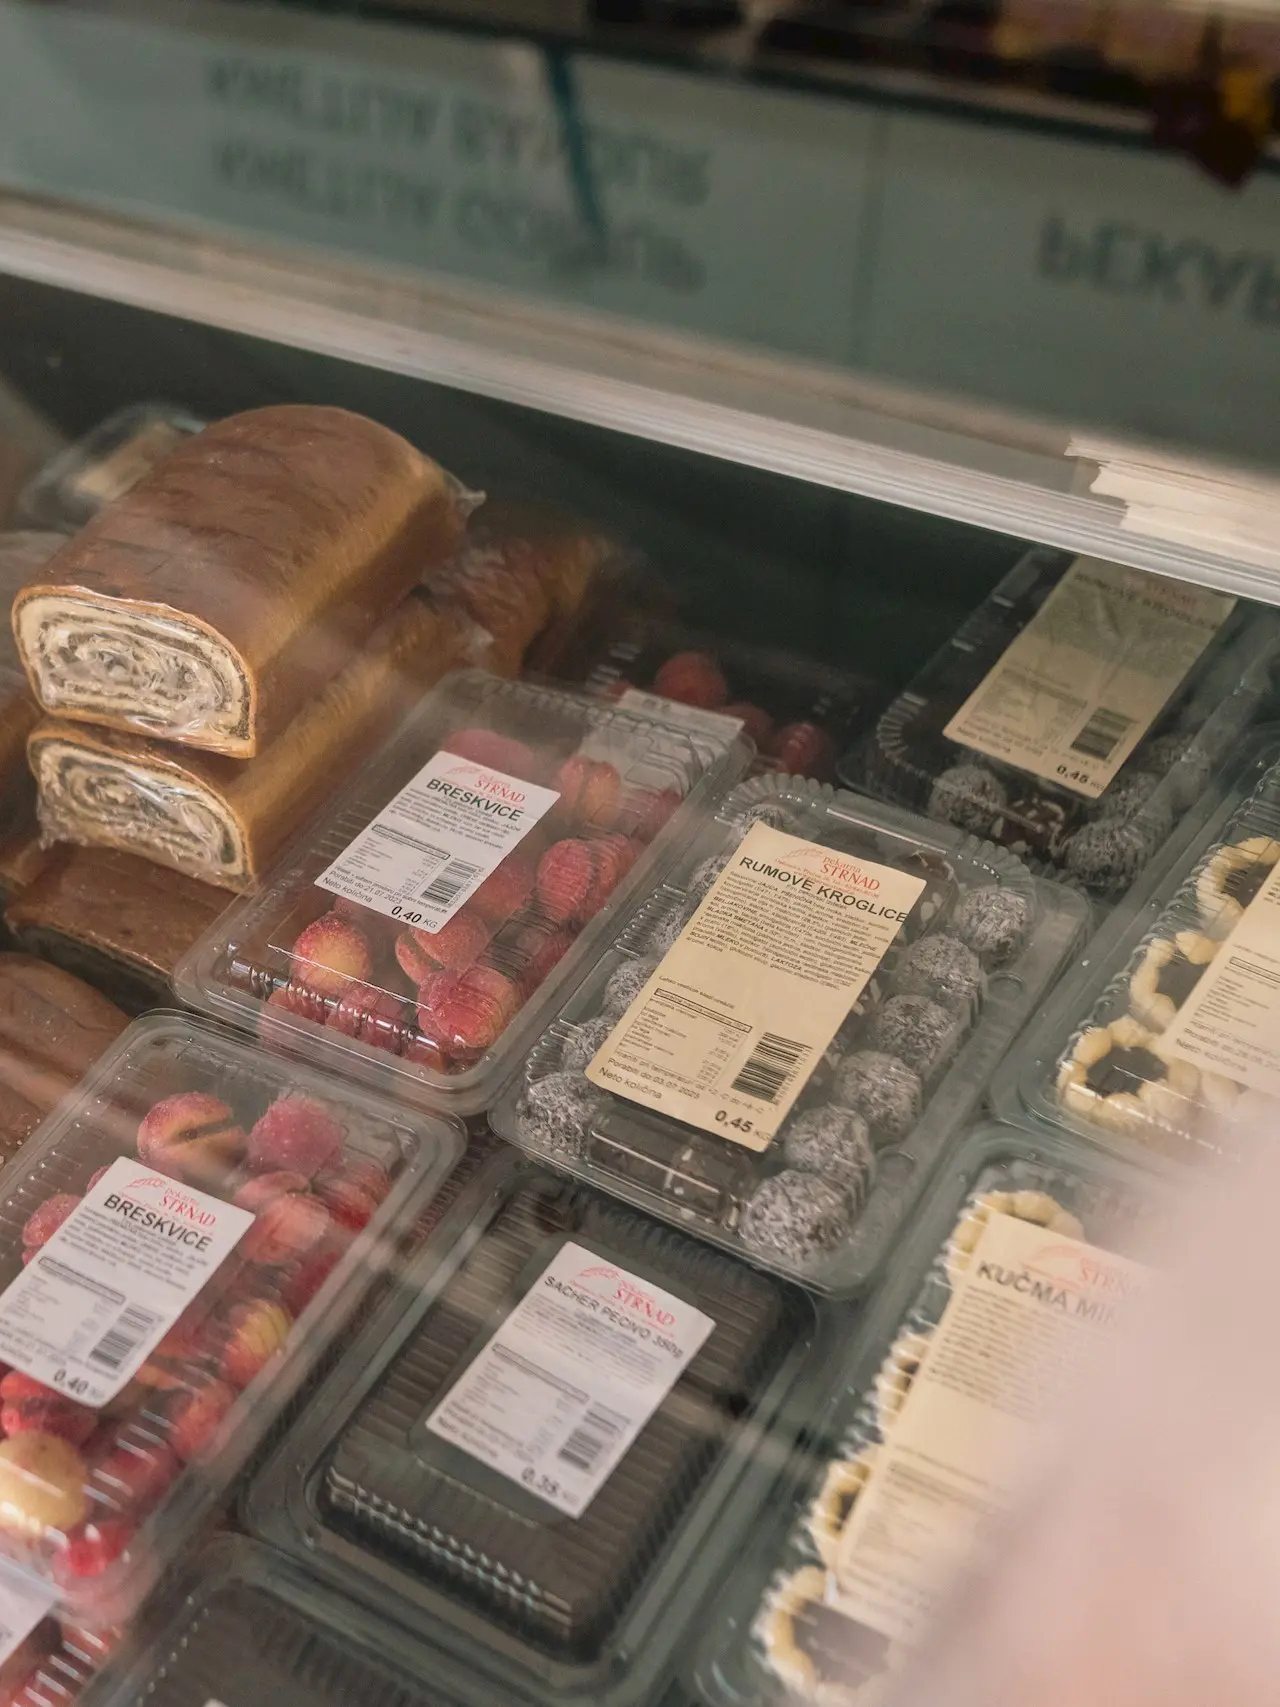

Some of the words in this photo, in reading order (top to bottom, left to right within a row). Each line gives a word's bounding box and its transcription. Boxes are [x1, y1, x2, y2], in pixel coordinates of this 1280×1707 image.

[425, 780, 523, 819] BRESKVICE
[473, 779, 527, 802] STRNAD
[322, 877, 342, 888] Neto
[341, 885, 374, 902] količina
[740, 858, 814, 889] RUMOVE
[817, 885, 906, 922] KROGLICE
[821, 862, 880, 891] STRNAD
[389, 905, 422, 923] 0,40
[422, 918, 438, 928] KG
[607, 1058, 639, 1074] Porabiti
[598, 1067, 624, 1082] Neto
[623, 1077, 664, 1098] količina
[713, 1109, 754, 1134] 0,45
[103, 1195, 212, 1251] BRESKVICE
[158, 1195, 218, 1227] STRNAD
[544, 1276, 600, 1310] SACHER
[976, 1256, 1073, 1308] KUČMA
[613, 1287, 676, 1327] STRNAD
[50, 1367, 90, 1395] 0,40
